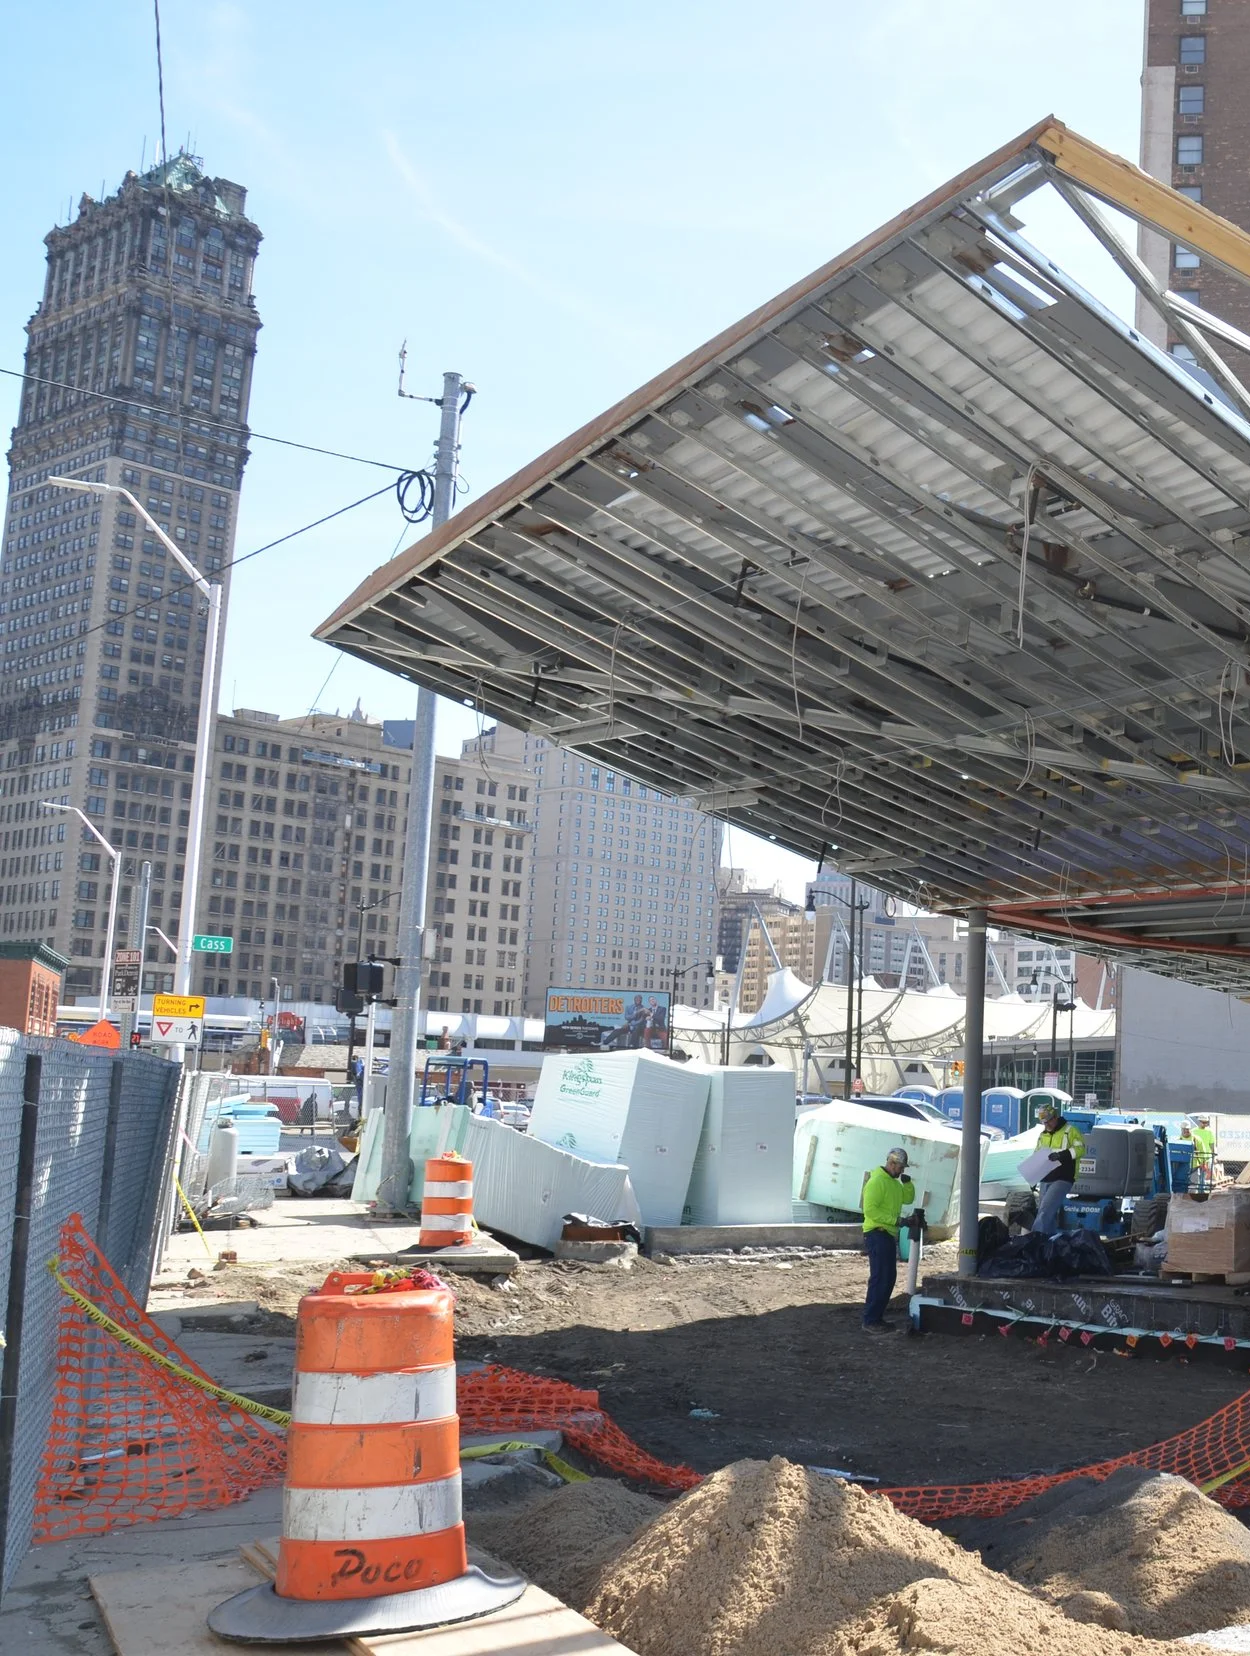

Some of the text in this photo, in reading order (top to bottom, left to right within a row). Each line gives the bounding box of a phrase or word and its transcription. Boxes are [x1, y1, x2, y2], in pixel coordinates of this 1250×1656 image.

[200, 937, 225, 950] Cass
[116, 951, 130, 962] ZONE
[157, 999, 187, 1007] TURNING
[549, 995, 624, 1015] DETROITERS
[155, 1007, 187, 1015] VEHICLES
[559, 1083, 601, 1098] GreenGuard
